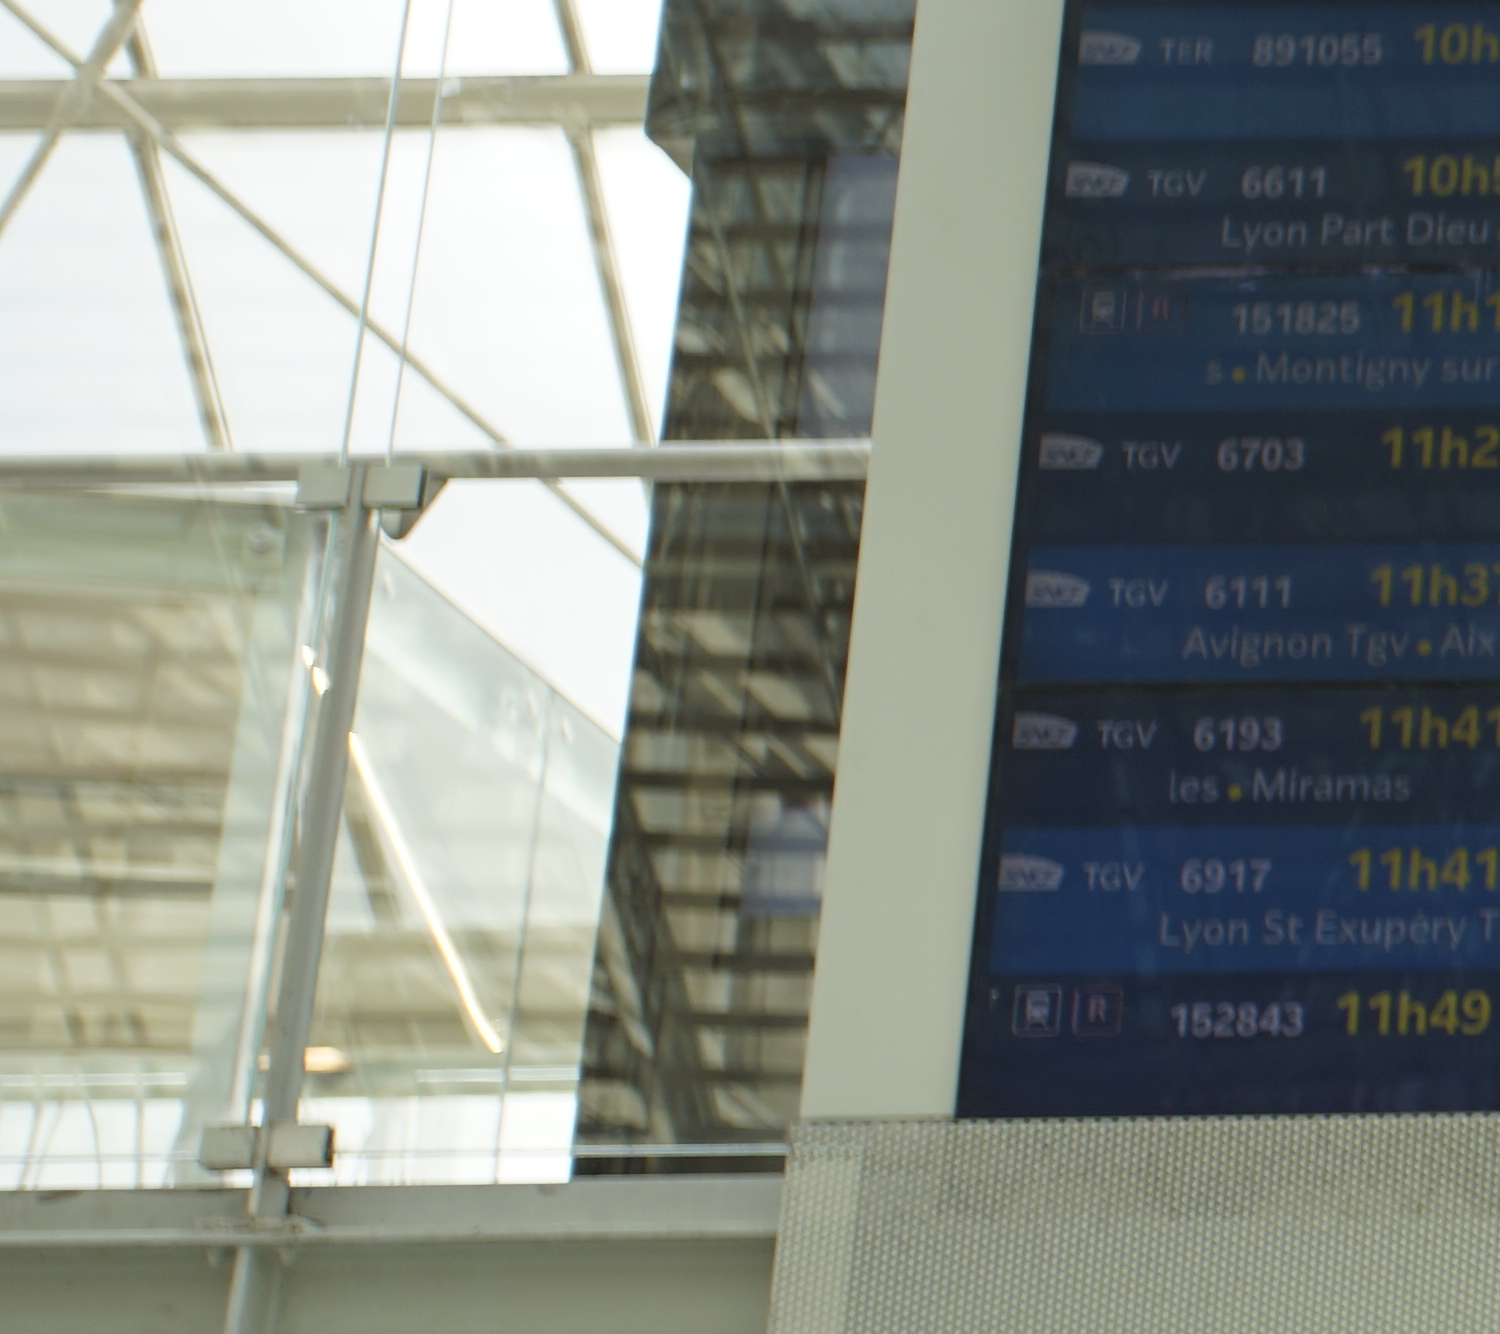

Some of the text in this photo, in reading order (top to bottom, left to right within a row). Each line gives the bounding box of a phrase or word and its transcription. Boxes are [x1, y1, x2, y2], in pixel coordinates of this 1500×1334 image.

[1148, 168, 1205, 197] TGV
[1241, 164, 1327, 199] 6611
[1223, 215, 1308, 253] Lyon
[1322, 212, 1392, 247] Part
[1408, 212, 1488, 244] Dieu
[1255, 349, 1431, 390] Montigny
[1442, 357, 1500, 382] sur
[1123, 439, 1180, 468] TGV
[1217, 435, 1305, 471] 6703
[1110, 577, 1168, 606] TGV
[1205, 573, 1291, 608] 6111
[1183, 625, 1331, 665] Avignon
[1345, 624, 1409, 663] Tgv
[1441, 622, 1498, 657] Aix
[1097, 719, 1156, 748] TGV
[1194, 714, 1283, 751] 6193
[1253, 768, 1411, 802] Miramas
[1084, 860, 1145, 891] TGV
[1181, 857, 1271, 893] 6917
[1348, 848, 1499, 891] 11h41
[1159, 911, 1248, 950] Lyon
[1262, 911, 1301, 946] St
[1315, 909, 1466, 952] Exupéry
[1170, 1001, 1303, 1037] 152843
[1338, 990, 1491, 1035] 11h49
